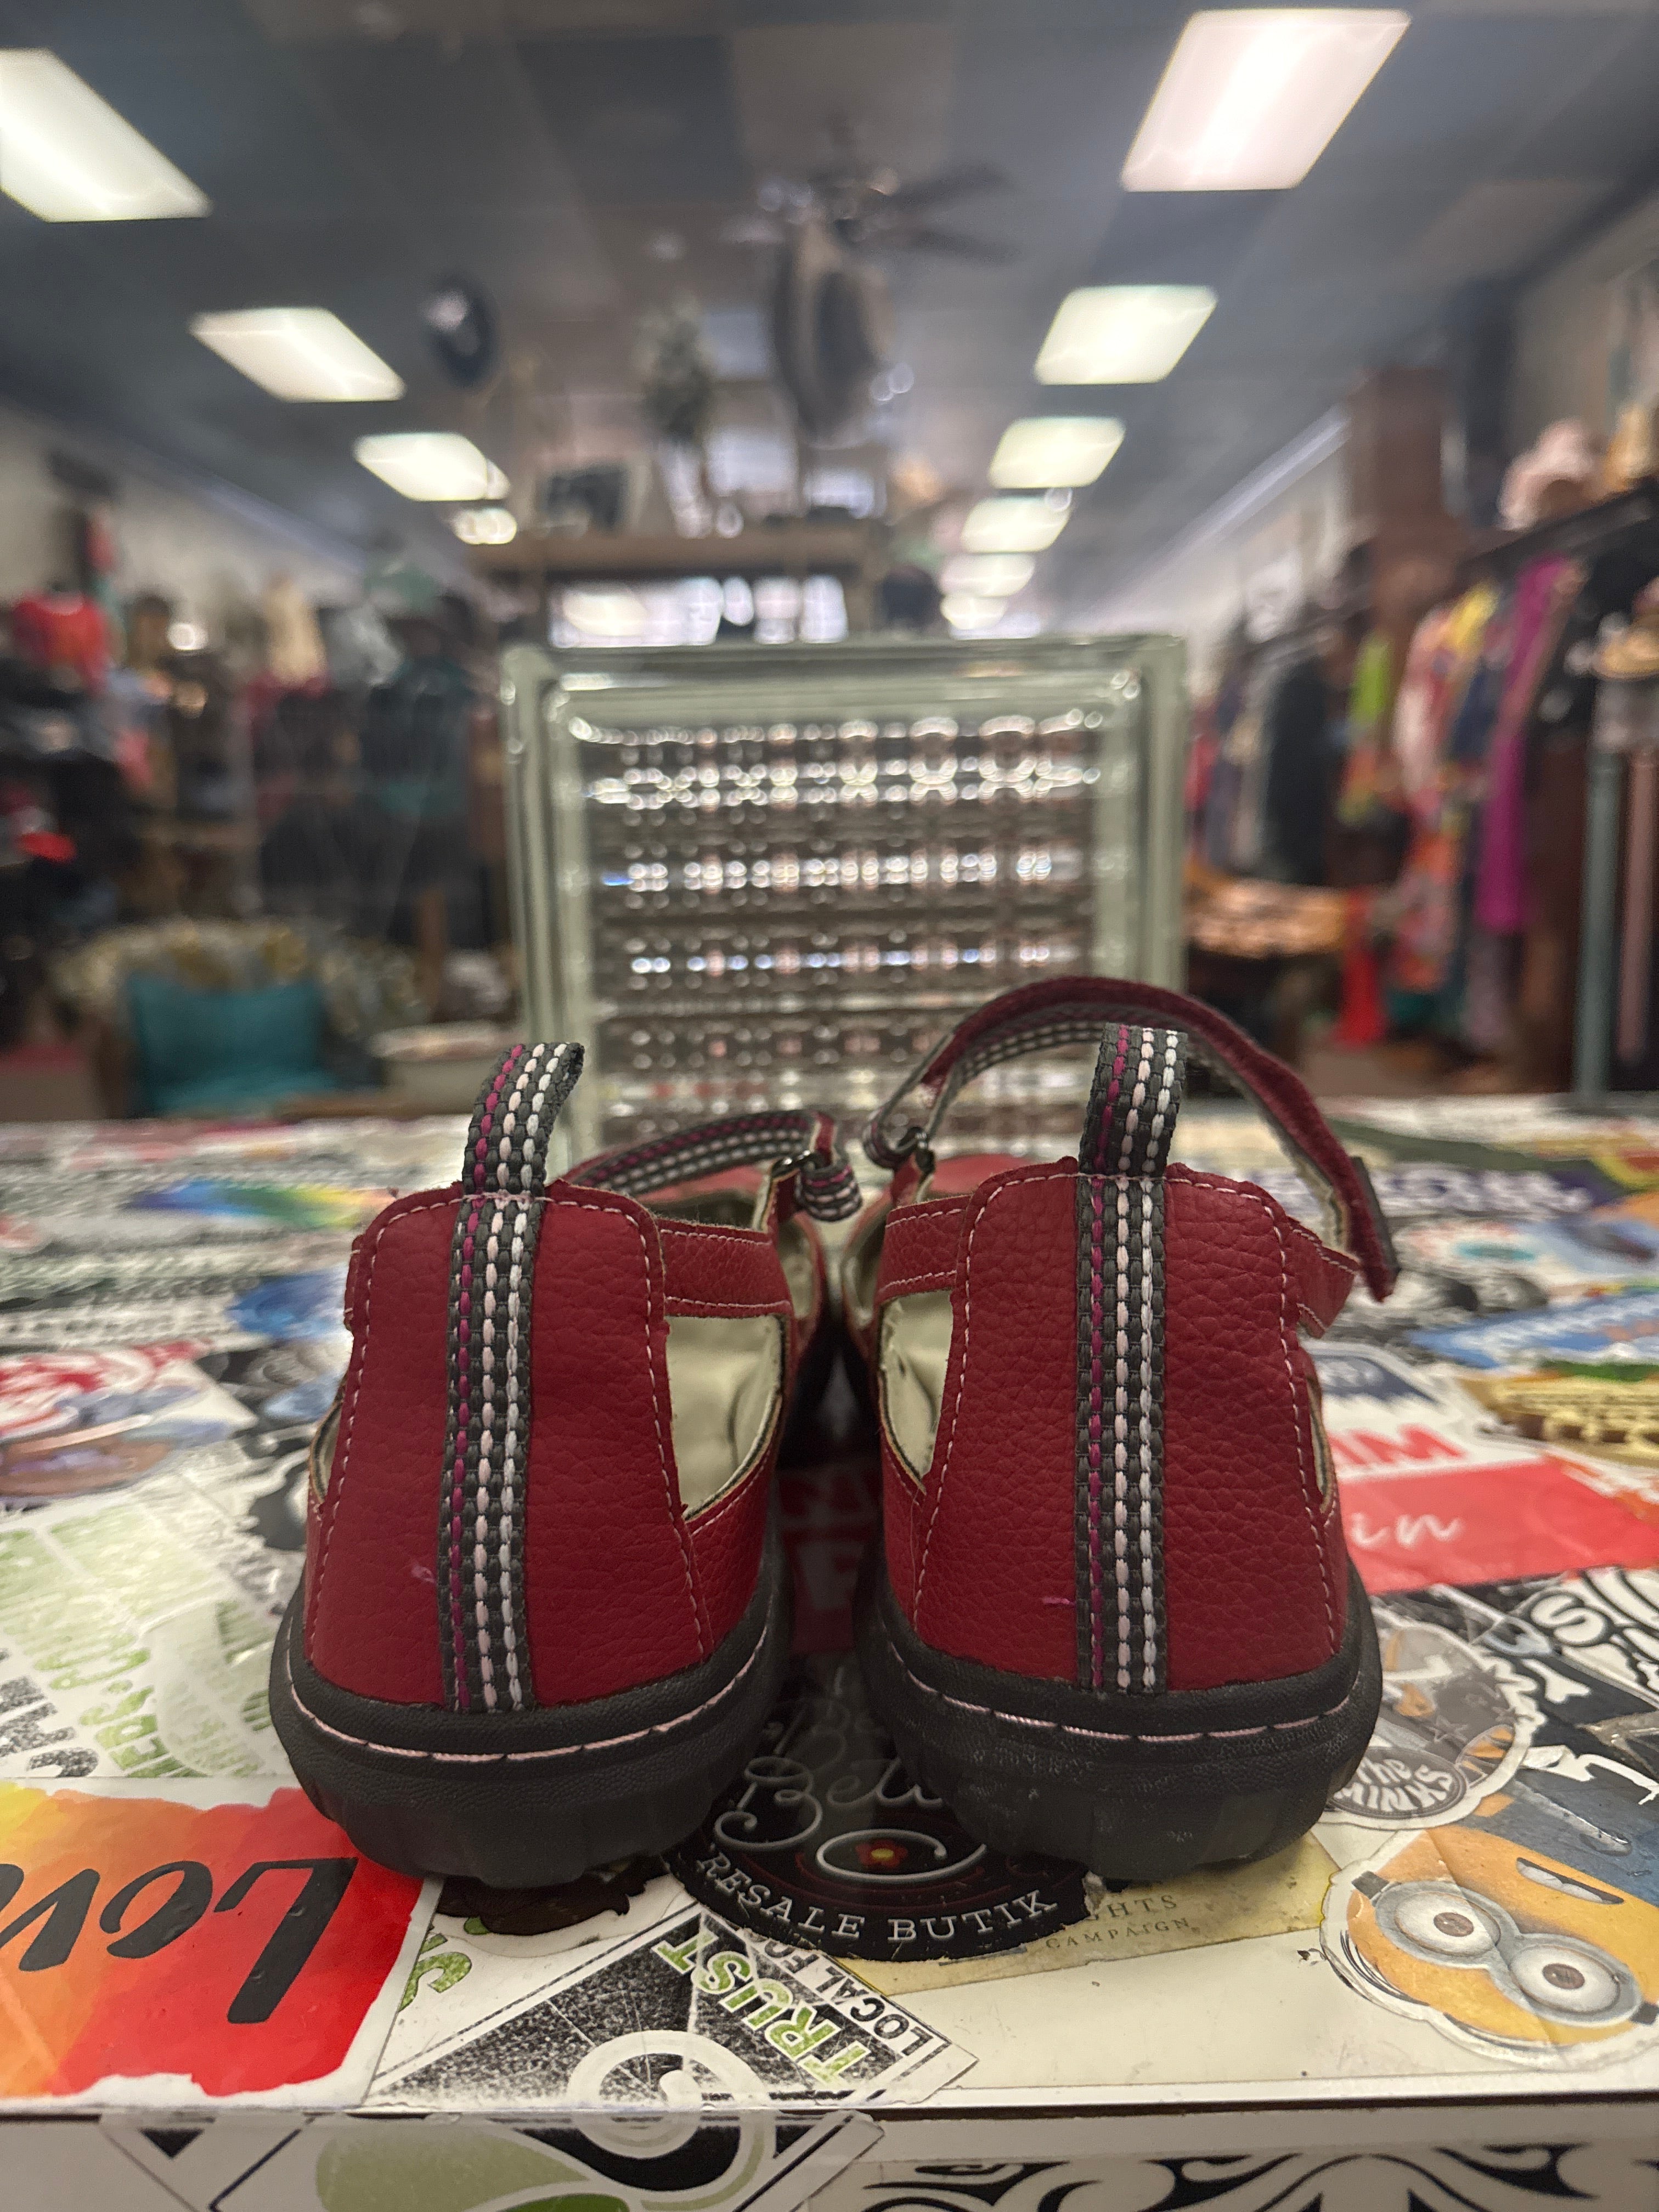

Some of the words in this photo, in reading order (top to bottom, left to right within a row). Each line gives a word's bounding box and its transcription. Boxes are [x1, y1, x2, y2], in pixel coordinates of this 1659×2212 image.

[0, 1858, 358, 2024] Lov
[695, 1847, 866, 1940] RESALE
[887, 1889, 1058, 1942] BUTIK
[1045, 1916, 1192, 1949] CAMPAIGN
[1095, 1894, 1177, 1919] HTS
[652, 1928, 871, 2087] TRUST
[816, 1965, 934, 2057] LOCAL
